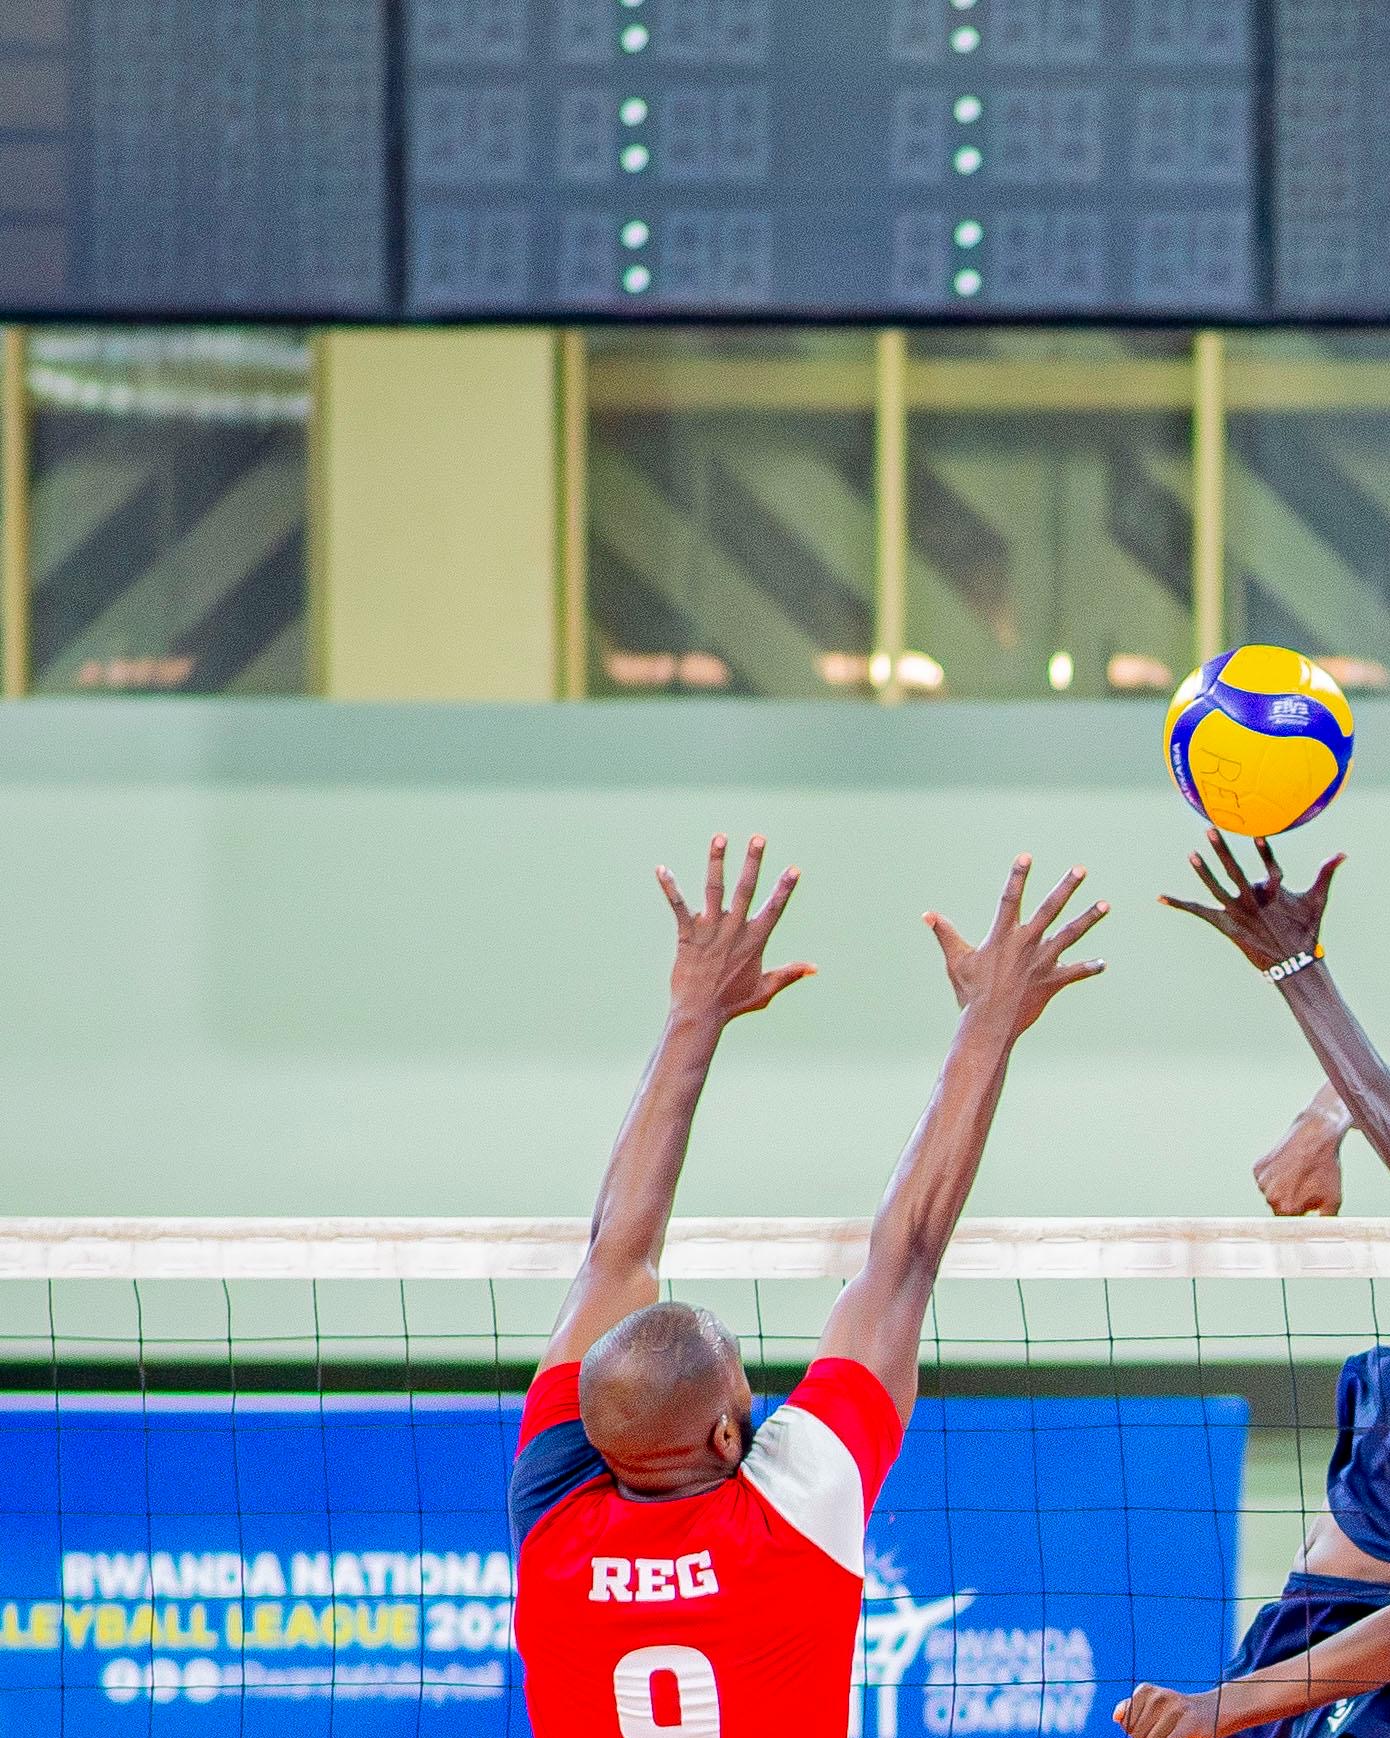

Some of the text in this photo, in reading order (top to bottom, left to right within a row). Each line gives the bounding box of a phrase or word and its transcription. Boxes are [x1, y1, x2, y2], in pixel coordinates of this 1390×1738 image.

[61, 1551, 518, 1599] RWANDA NATIONA
[588, 1549, 720, 1602] REG
[0, 1603, 218, 1650] LEYBALL
[226, 1603, 420, 1650] LEAGUE
